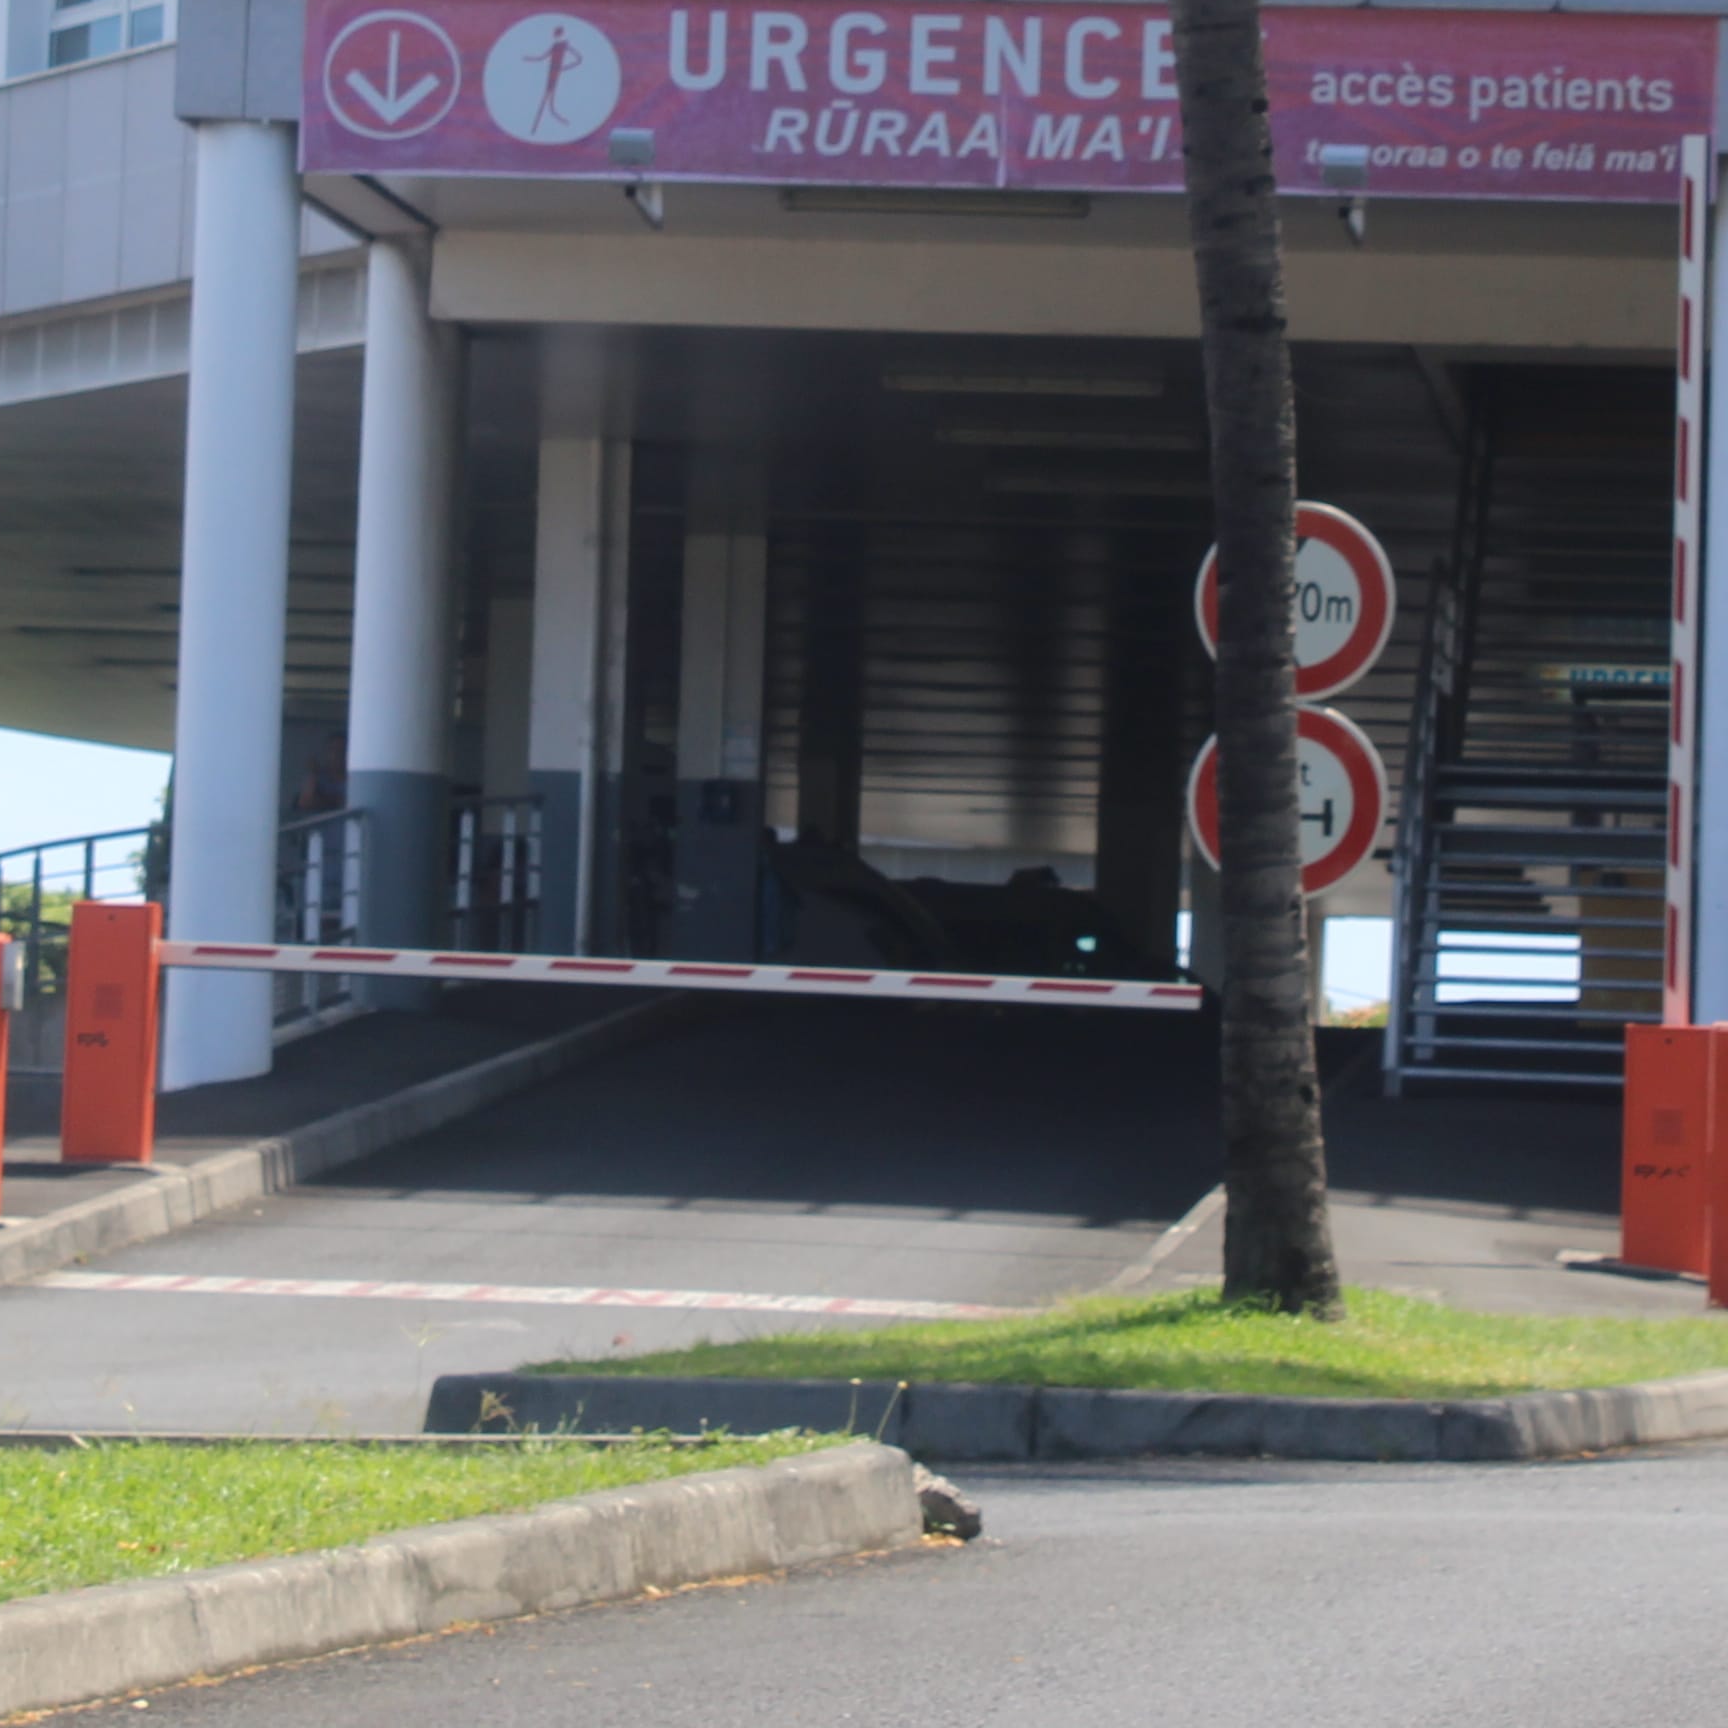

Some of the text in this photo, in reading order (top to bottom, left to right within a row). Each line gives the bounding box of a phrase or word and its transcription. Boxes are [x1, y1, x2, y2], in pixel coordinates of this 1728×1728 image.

[1310, 63, 1674, 122] accès patients
[1458, 147, 1479, 168] o
[1490, 143, 1522, 169] te
